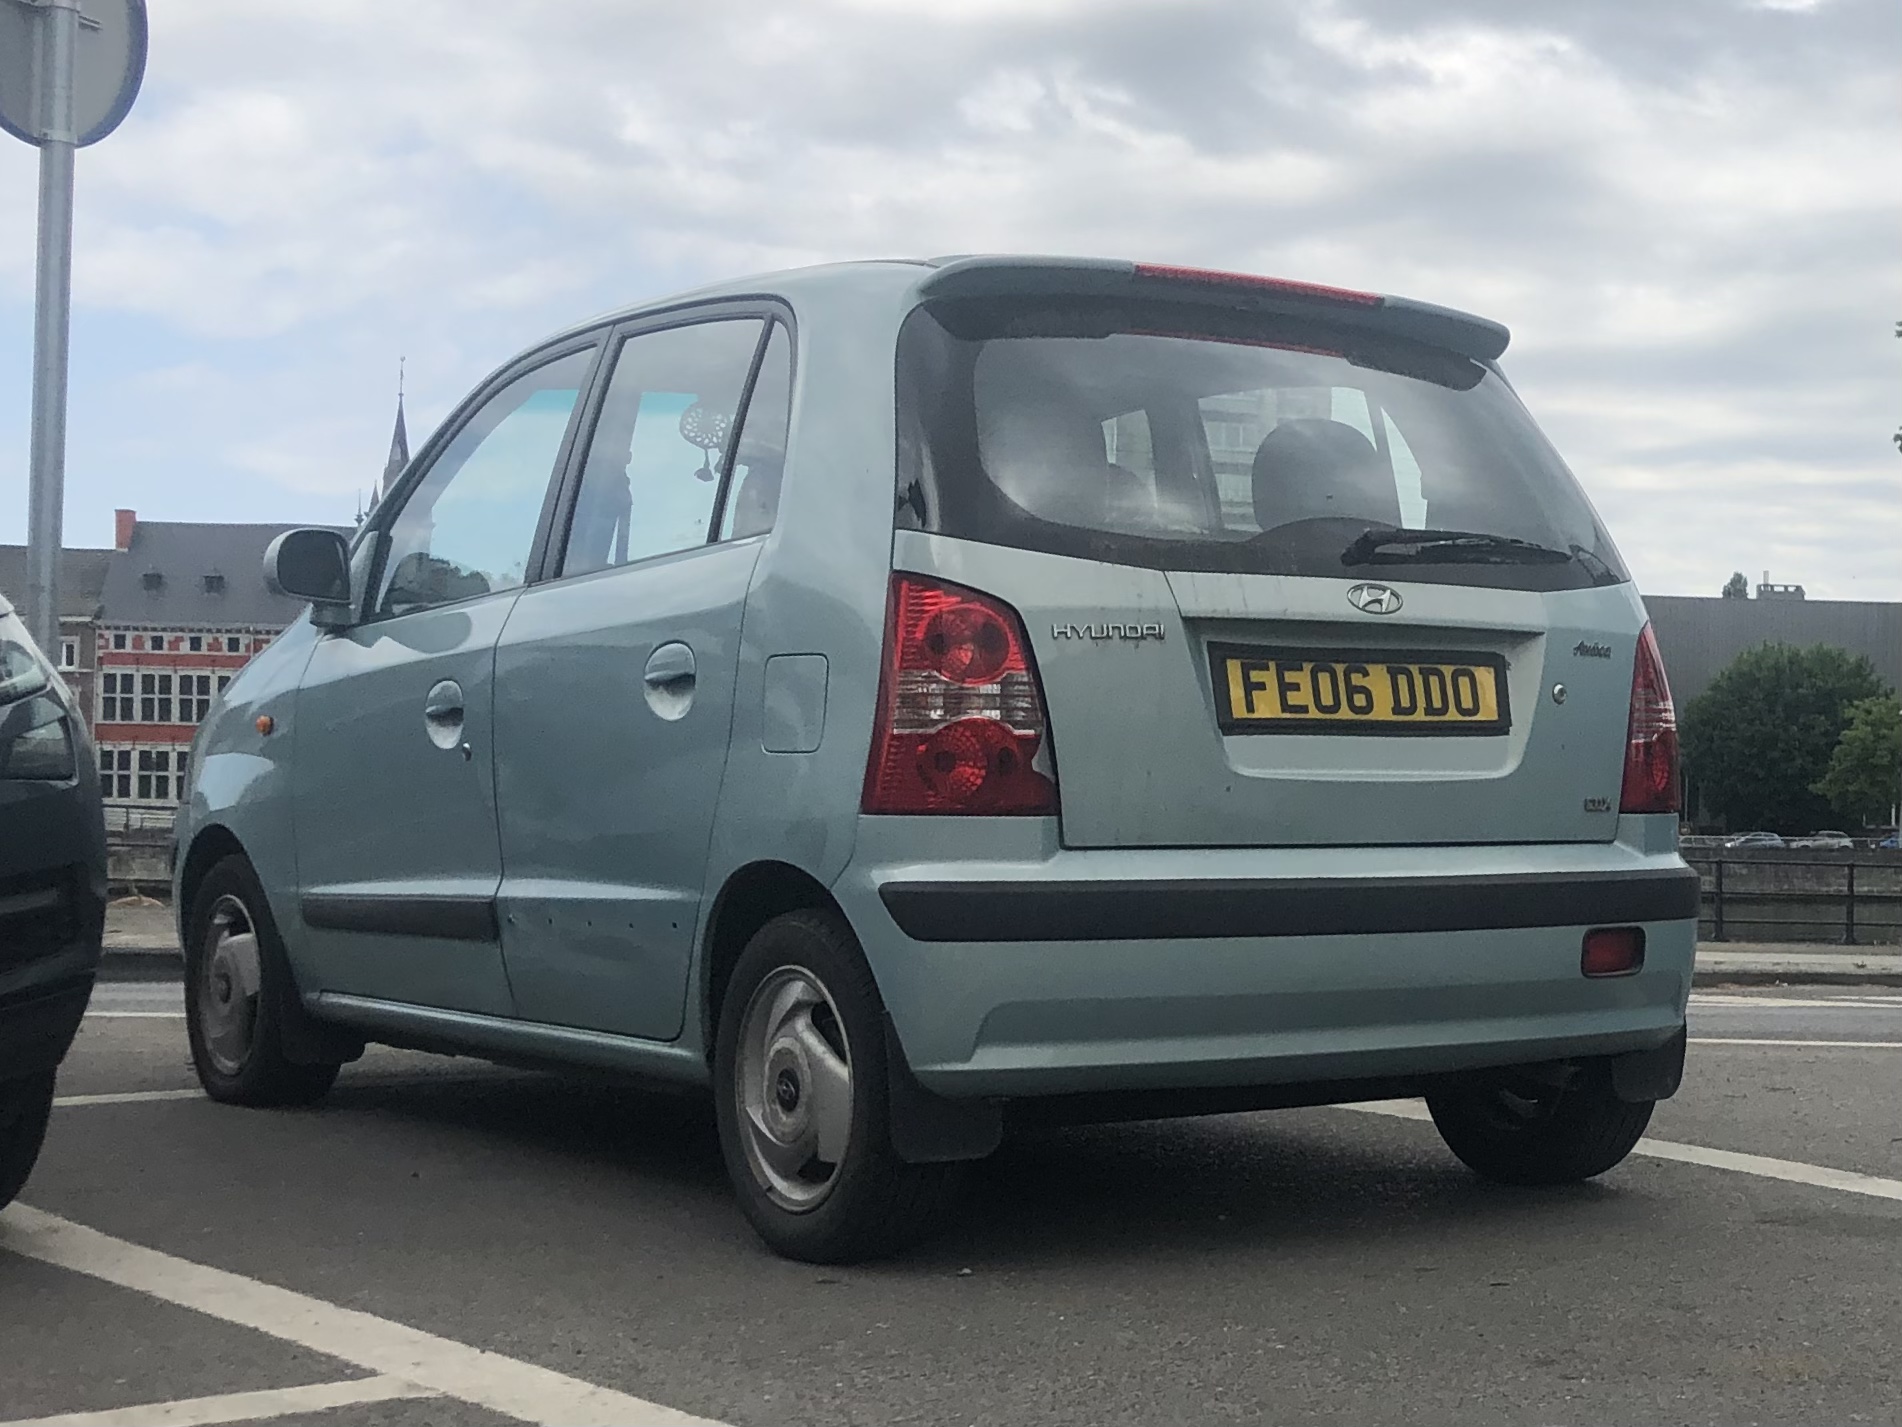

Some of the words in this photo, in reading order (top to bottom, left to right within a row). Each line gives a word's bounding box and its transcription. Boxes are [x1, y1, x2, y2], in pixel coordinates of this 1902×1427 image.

[1052, 623, 1165, 640] HYUNDAI
[1240, 661, 1374, 716] FE06
[1387, 666, 1480, 717] DDO
